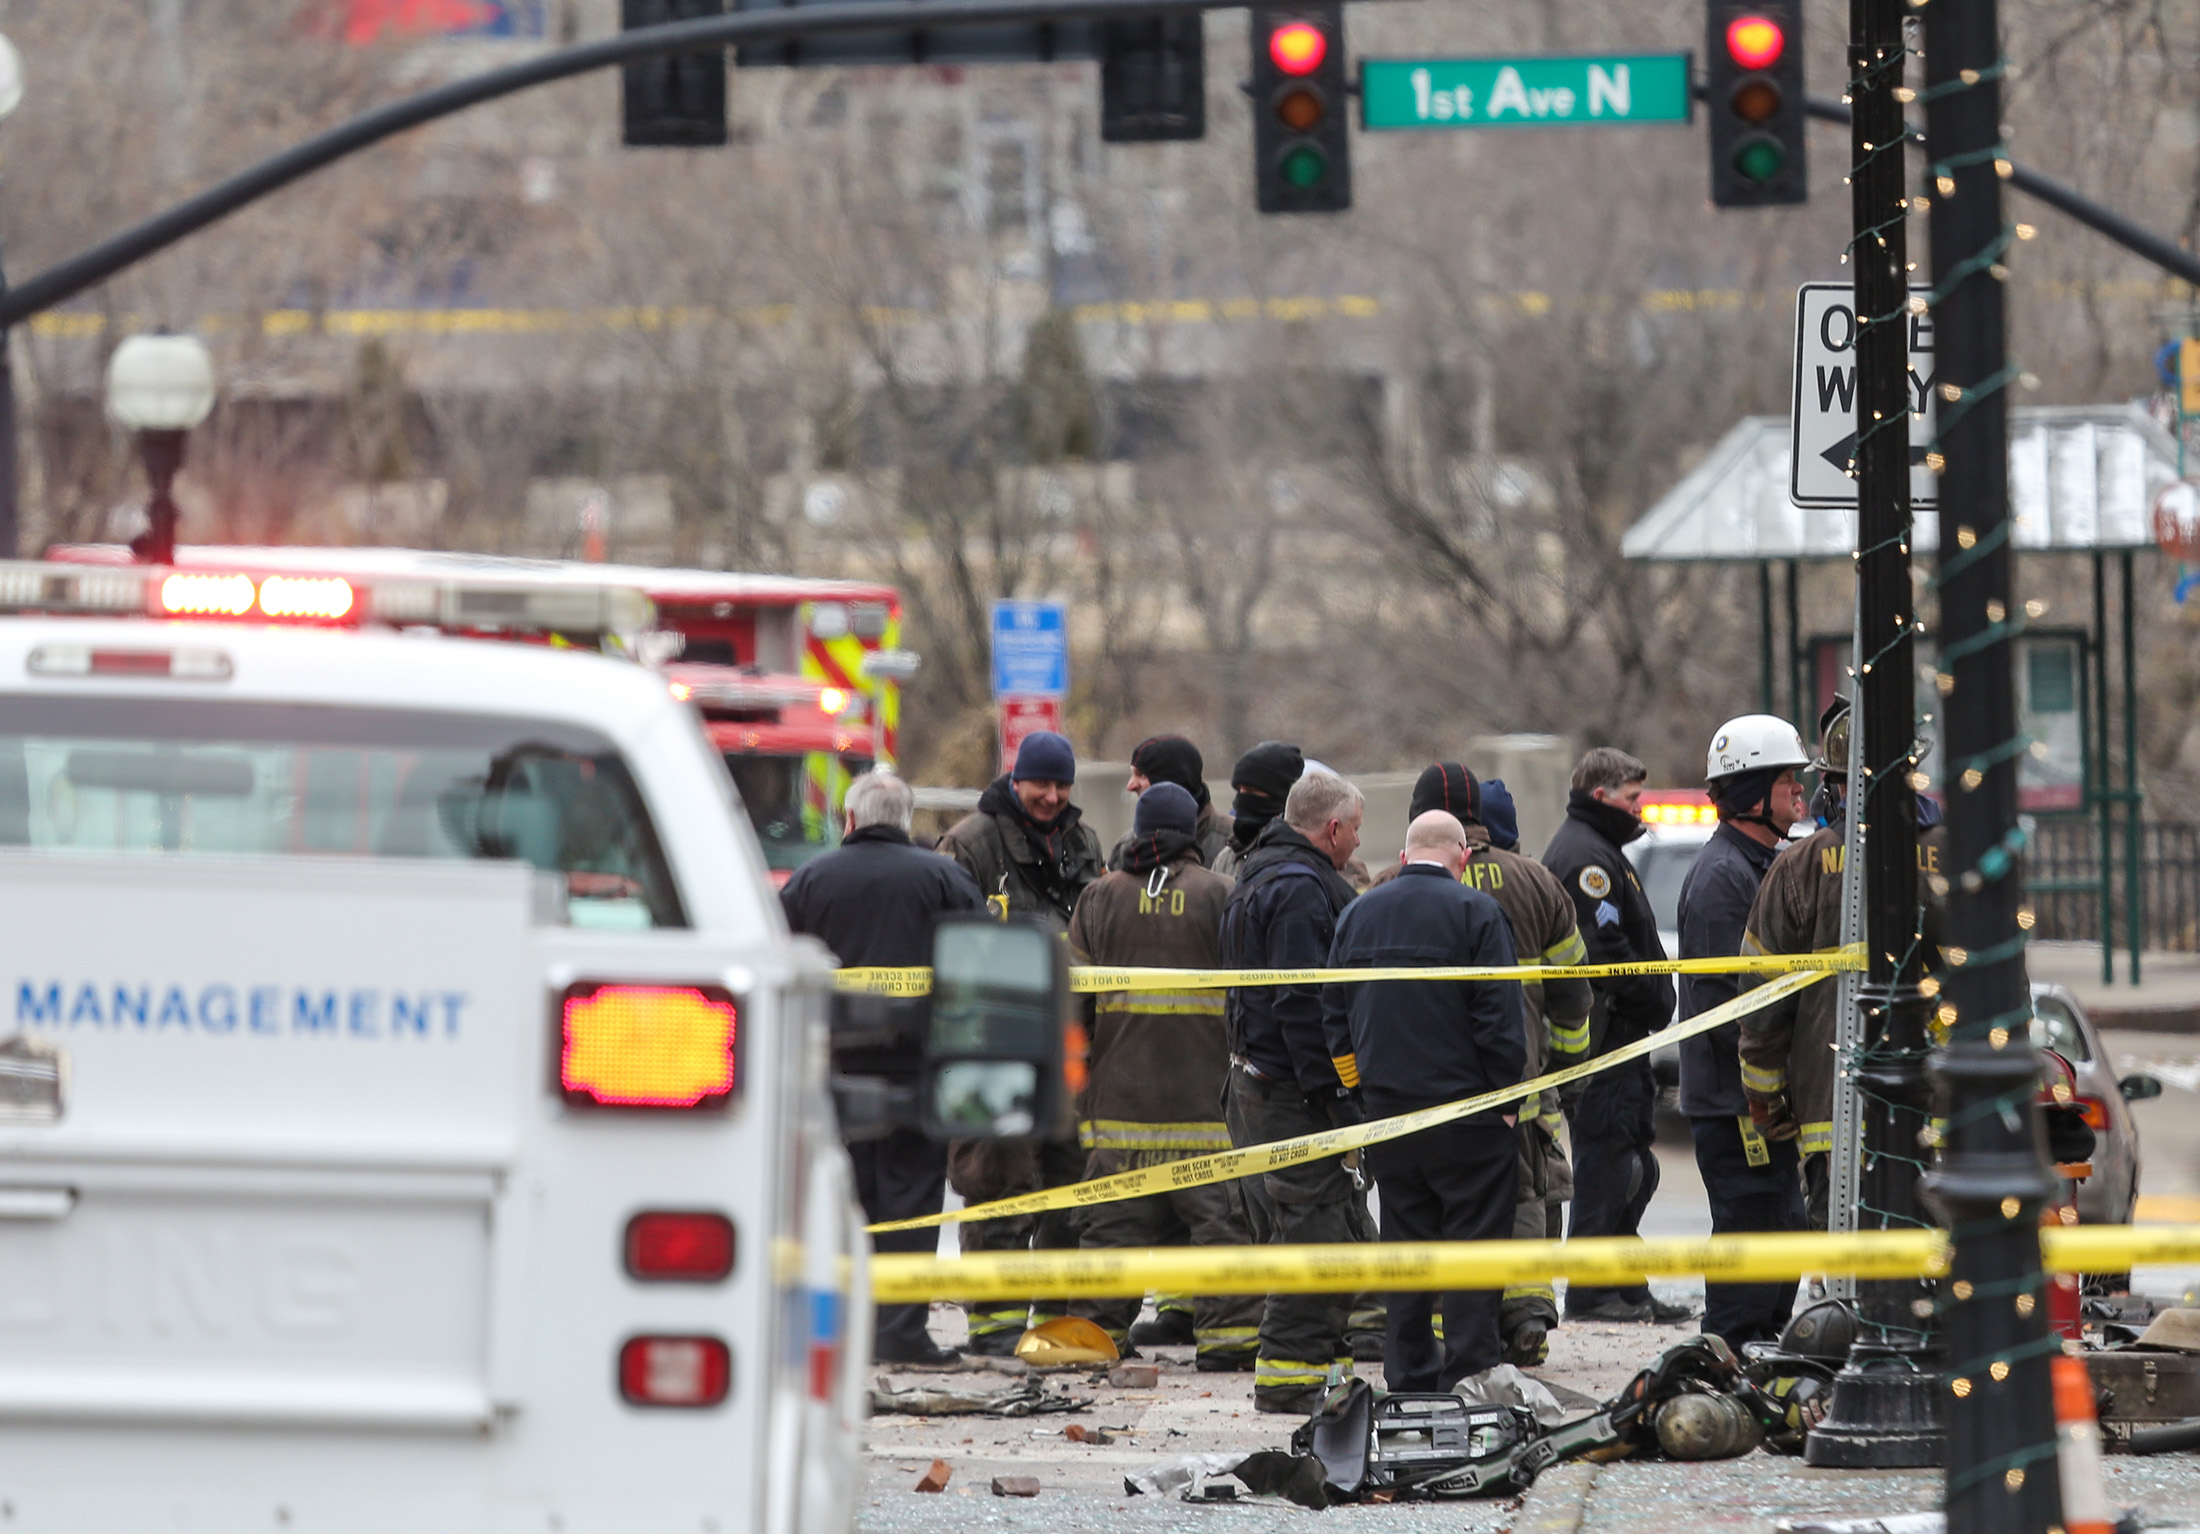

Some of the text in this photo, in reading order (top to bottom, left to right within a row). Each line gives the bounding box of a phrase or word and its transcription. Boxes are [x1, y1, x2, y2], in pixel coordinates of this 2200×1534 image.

[1410, 64, 1631, 120] 1st Ave N
[1820, 304, 1935, 353] OE
[1816, 365, 1936, 414] WY
[1139, 888, 1185, 916] NFD
[15, 979, 469, 1042] MANAGEMENT
[1171, 1161, 1192, 1176] CRIME
[1192, 1159, 1212, 1170] SCENE
